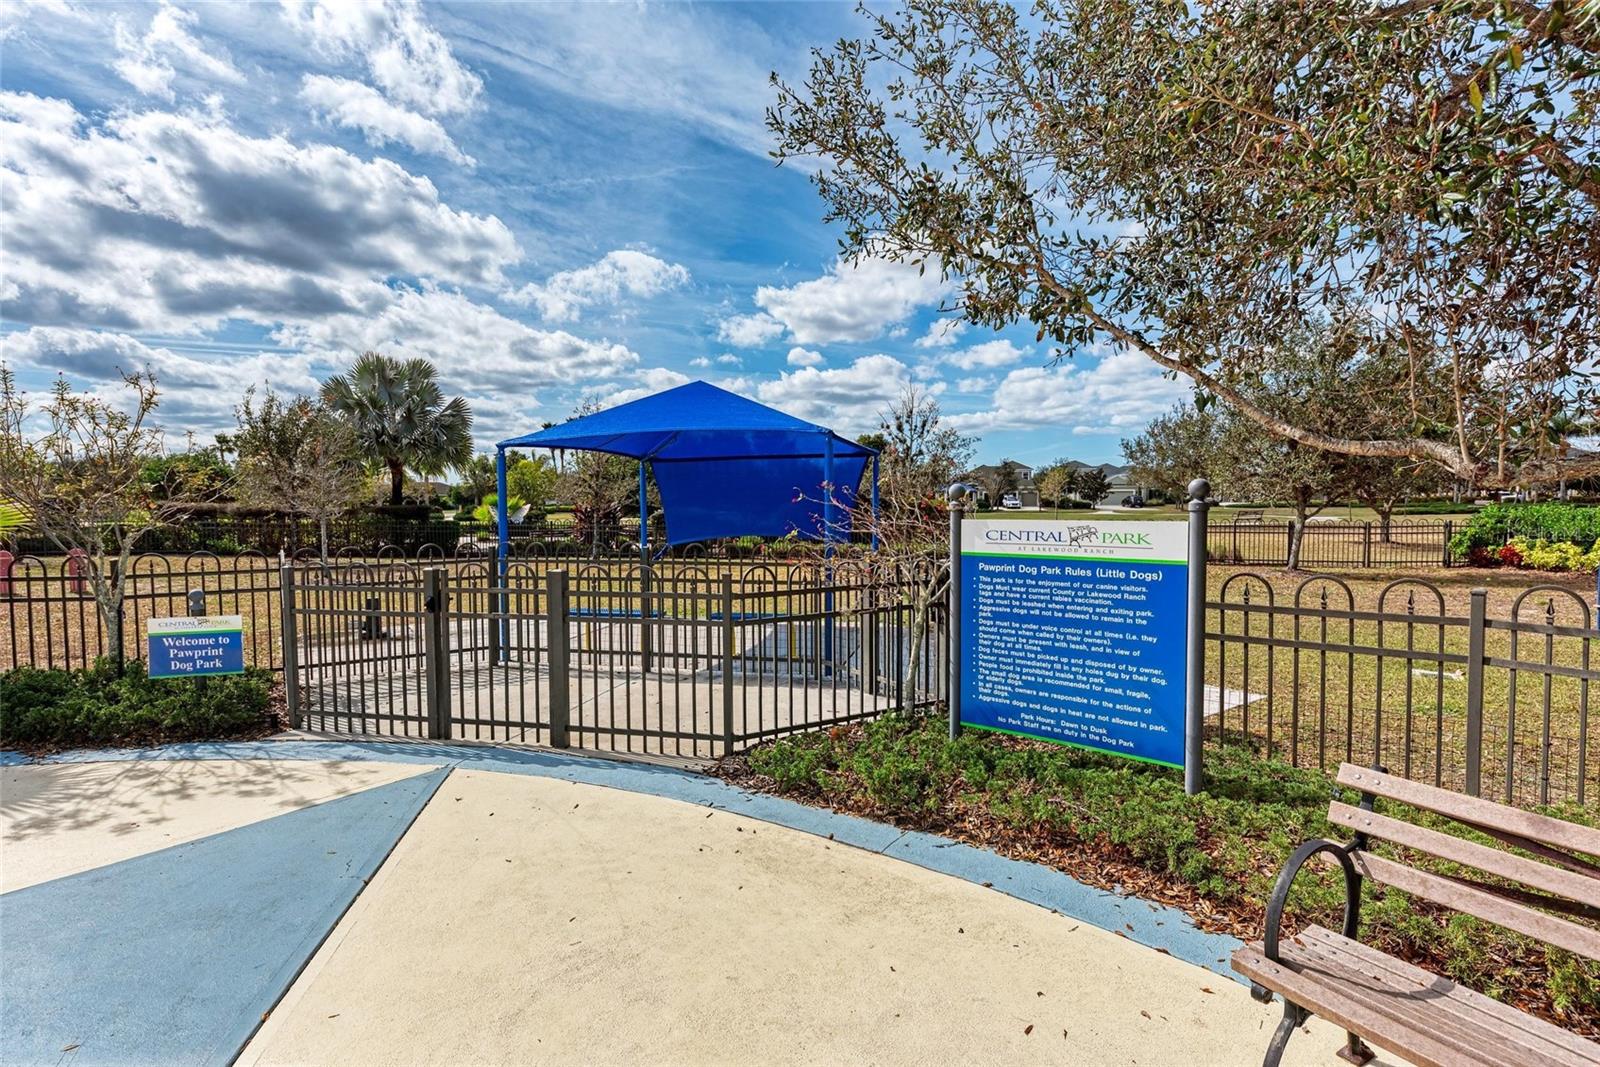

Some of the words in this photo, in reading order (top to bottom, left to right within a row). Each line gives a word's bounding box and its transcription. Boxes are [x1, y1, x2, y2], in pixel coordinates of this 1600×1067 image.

[985, 529, 1067, 543] CENTRAL
[1102, 532, 1153, 546] PARK
[978, 562, 1015, 573] Pawprint
[1018, 564, 1037, 575] Dog
[1040, 565, 1061, 575] Park
[1065, 567, 1092, 577] Rules
[1096, 567, 1126, 579] (Little
[1130, 570, 1163, 582] Dogs)
[979, 583, 994, 591] Dogs
[1052, 588, 1075, 597] County
[1087, 591, 1122, 599] Lakewood
[1123, 593, 1146, 601] Ranch
[979, 604, 1011, 613] Aggressive
[1012, 607, 1027, 615] dogs
[1064, 612, 1090, 620] allowed
[1066, 605, 1093, 613] entering
[1110, 608, 1134, 617] exiting
[978, 618, 994, 626] Dogs
[1104, 631, 1123, 639] times
[1141, 635, 1157, 643] they
[1056, 633, 1064, 641] by
[1083, 637, 1112, 645] owners).
[162, 636, 216, 647] Welcome
[218, 636, 230, 644] to
[978, 632, 1000, 640] Owners
[1069, 643, 1089, 651] leash,
[169, 647, 223, 659] Pawprint
[978, 645, 991, 654] Dog
[992, 647, 1009, 655] feces
[1085, 660, 1116, 669] disposed
[1128, 665, 1137, 673] by
[1139, 667, 1163, 675] owner.
[170, 660, 193, 671] Dog
[196, 659, 223, 669] Park
[978, 653, 997, 661] Owner
[1015, 659, 1051, 669] immediately
[1071, 666, 1083, 674] any
[1085, 667, 1103, 676] holes
[1105, 671, 1119, 679] dug
[1121, 672, 1130, 680] by
[1132, 674, 1149, 682] their
[1151, 677, 1167, 686] dog.
[1008, 672, 1020, 680] dog
[1044, 678, 1090, 690] recommended
[1104, 687, 1124, 696] small,
[1126, 690, 1151, 700] fragile,
[978, 694, 1010, 704] Aggressive
[1011, 700, 1027, 708] dogs
[1042, 705, 1058, 713] dogs
[1068, 709, 1082, 717] heat
[1111, 717, 1138, 727] allowed
[1149, 724, 1167, 732] park.
[1020, 712, 1034, 721] Park
[1036, 715, 1056, 724] Hours:
[1060, 720, 1079, 729] Dawn
[1090, 725, 1107, 734] Dusk
[1023, 720, 1039, 728] Staff
[1063, 729, 1078, 737] duty
[1102, 736, 1116, 745] Dog
[1118, 739, 1134, 747] Park
